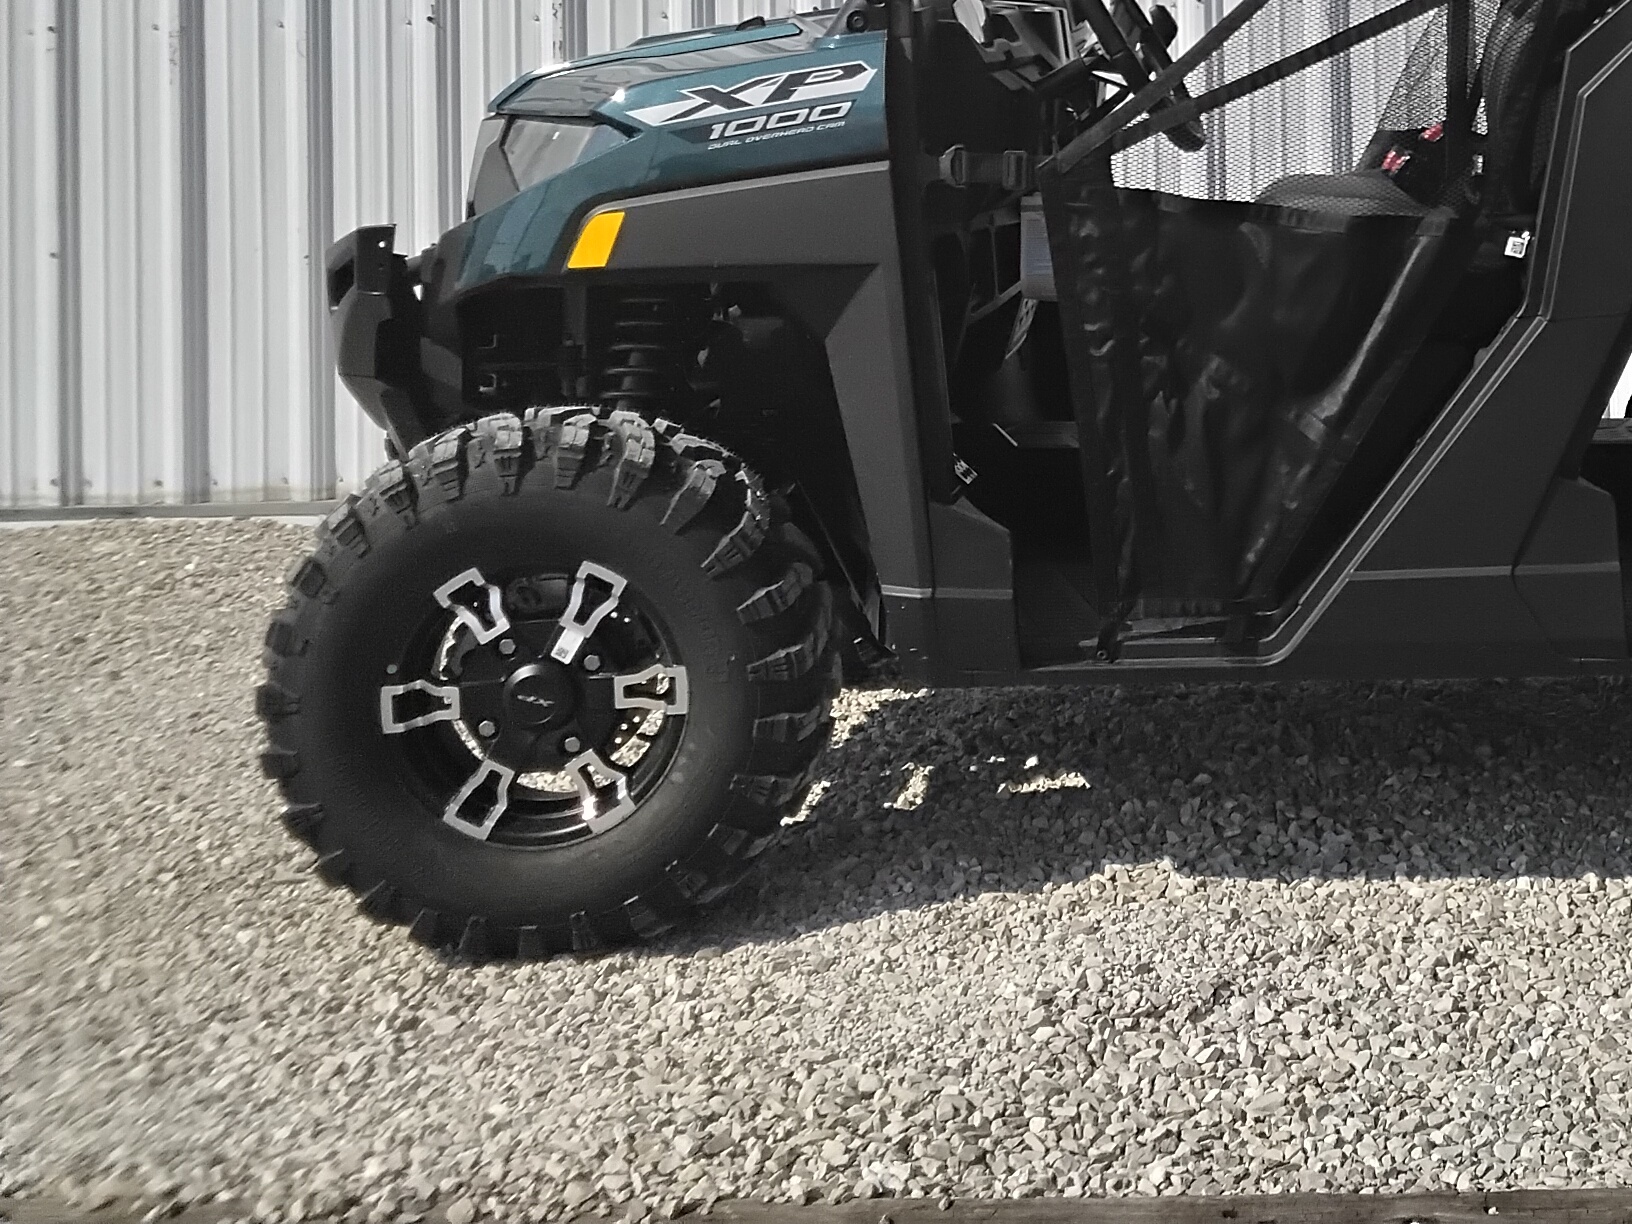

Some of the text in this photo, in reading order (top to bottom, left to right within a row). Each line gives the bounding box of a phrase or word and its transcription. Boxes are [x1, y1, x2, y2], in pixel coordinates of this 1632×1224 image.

[655, 61, 874, 124] XP
[708, 101, 853, 140] 1000
[708, 121, 846, 150] DUAL OVERHEAD CAM
